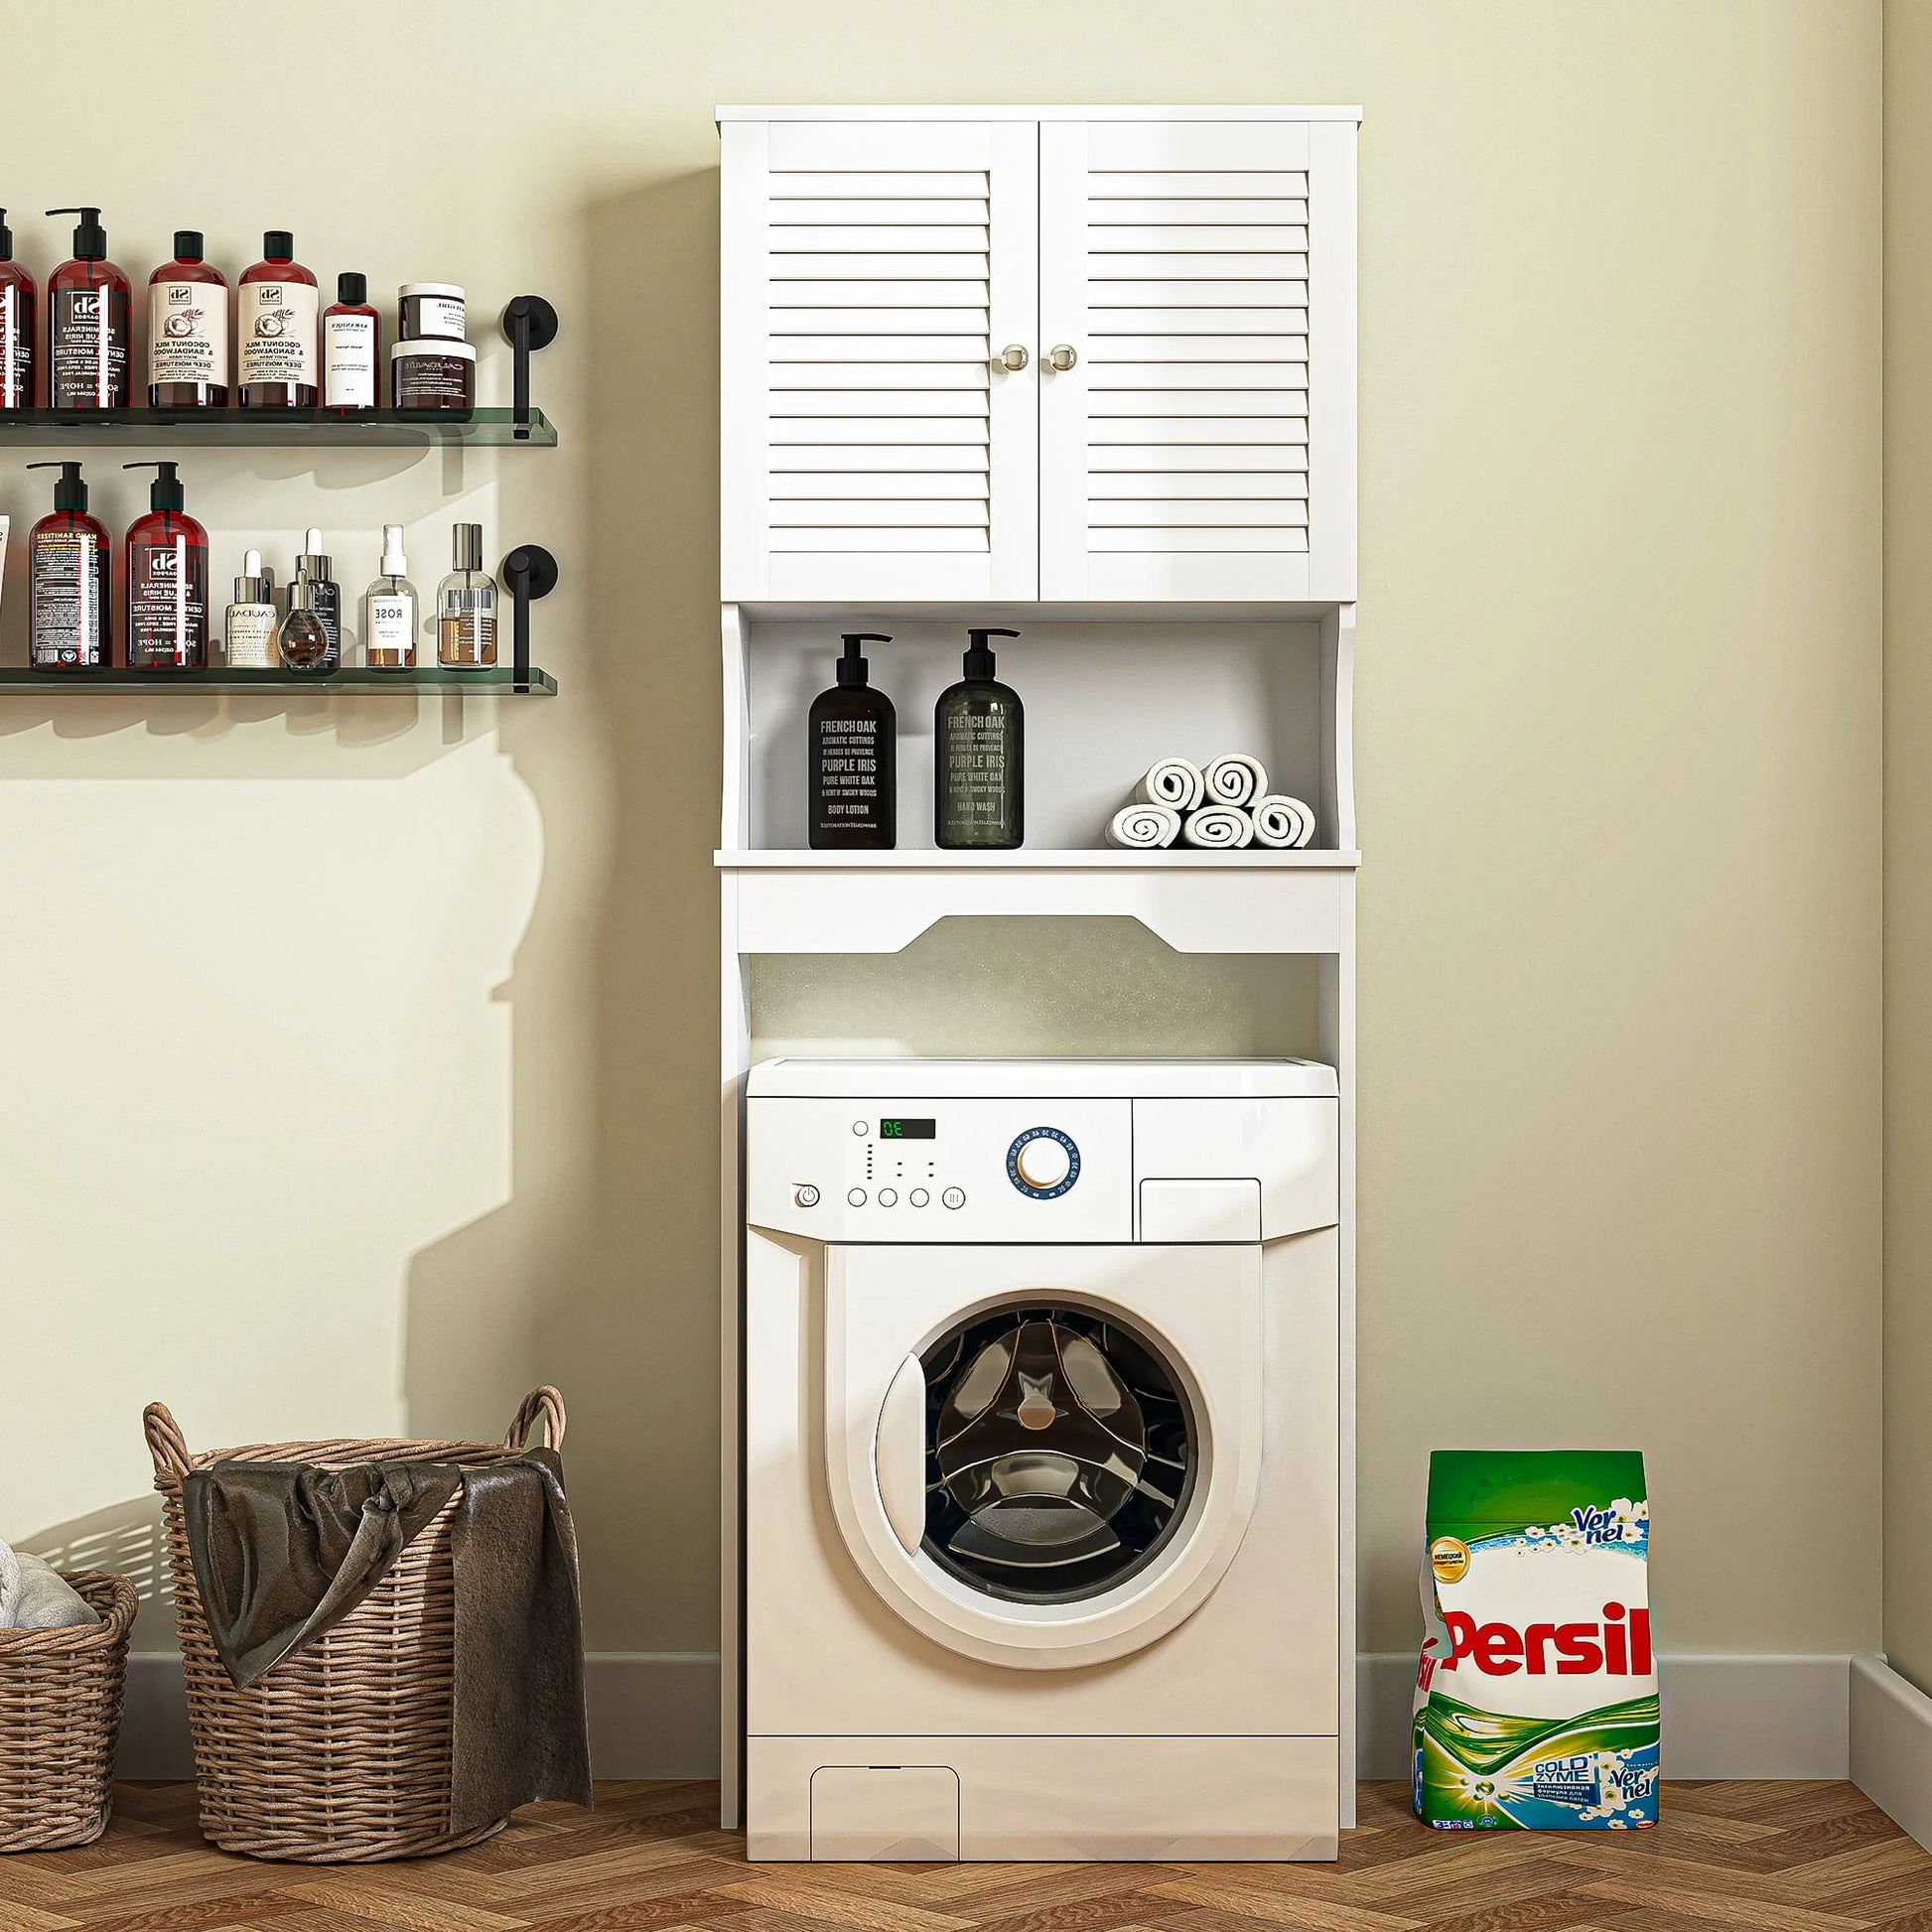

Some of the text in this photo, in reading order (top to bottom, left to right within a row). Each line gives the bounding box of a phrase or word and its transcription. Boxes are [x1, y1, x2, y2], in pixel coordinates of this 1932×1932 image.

[820, 720, 877, 734] FRENCH OAK
[948, 716, 1005, 729] FRENCH OAK
[821, 759, 877, 772] PURPLE IRIS
[949, 755, 1005, 768] PURPLE IRIS
[822, 775, 876, 785] PURE WHITE OAK
[950, 771, 966, 782] PURE
[967, 771, 989, 782] WHITE
[828, 804, 869, 814] BODY LOTION
[957, 801, 996, 812] HAND WASH
[1573, 1507, 1616, 1532] Ver
[1585, 1524, 1623, 1545] nel
[1439, 1600, 1652, 1677] Persil
[1534, 1756, 1588, 1774] COLD
[1536, 1770, 1589, 1783] ZYME
[1610, 1768, 1644, 1788] Ver
[1622, 1778, 1651, 1800] nel
